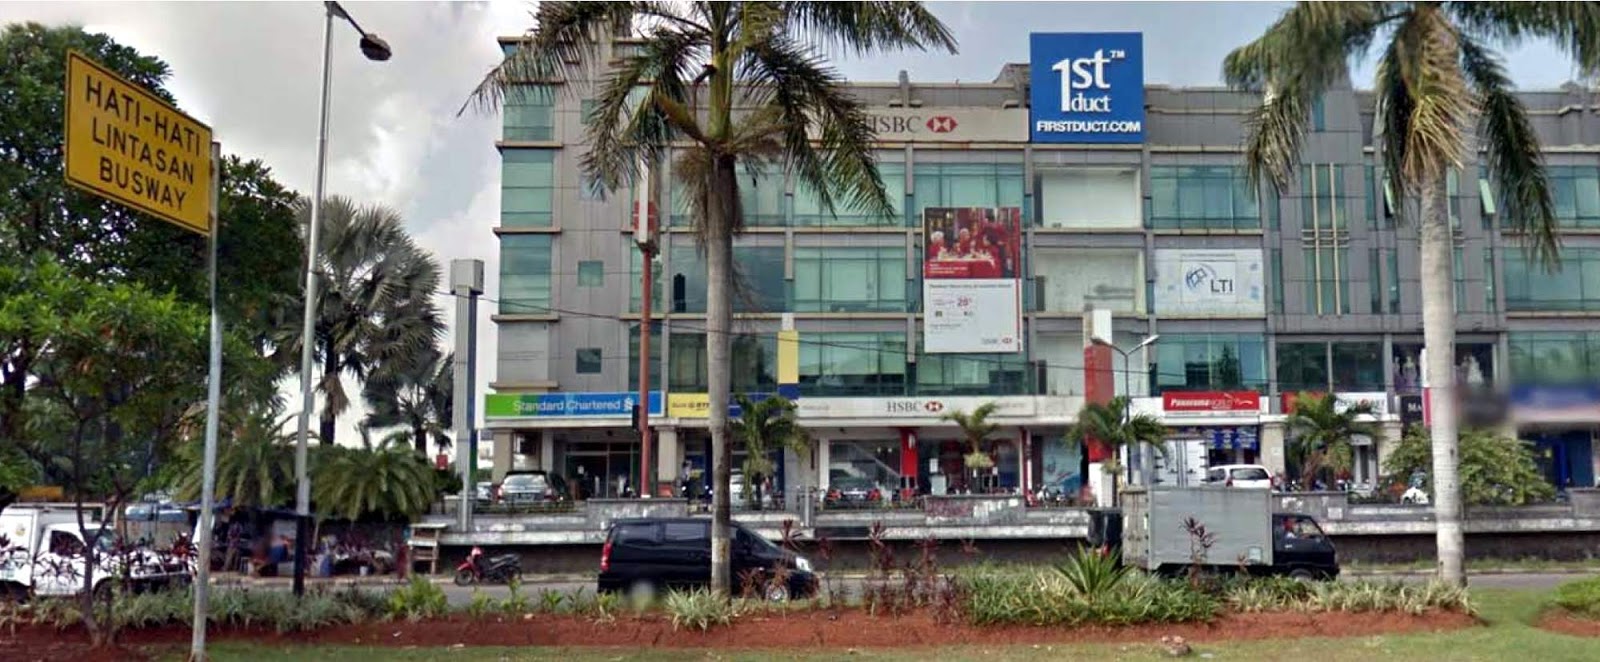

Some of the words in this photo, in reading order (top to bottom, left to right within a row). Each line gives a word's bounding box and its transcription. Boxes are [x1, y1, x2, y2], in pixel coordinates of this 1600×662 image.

[1052, 49, 1111, 112] 1st
[1071, 94, 1112, 112] duct
[86, 75, 200, 157] HATI-HATI
[1036, 120, 1141, 133] FIRSTDUCT.COM
[92, 117, 194, 185] LINTASAN
[100, 156, 186, 211] BUSWAY
[1211, 279, 1234, 293] LTI
[513, 400, 564, 412] Standard
[566, 398, 621, 411] Chartered
[887, 401, 921, 412] HSBC
